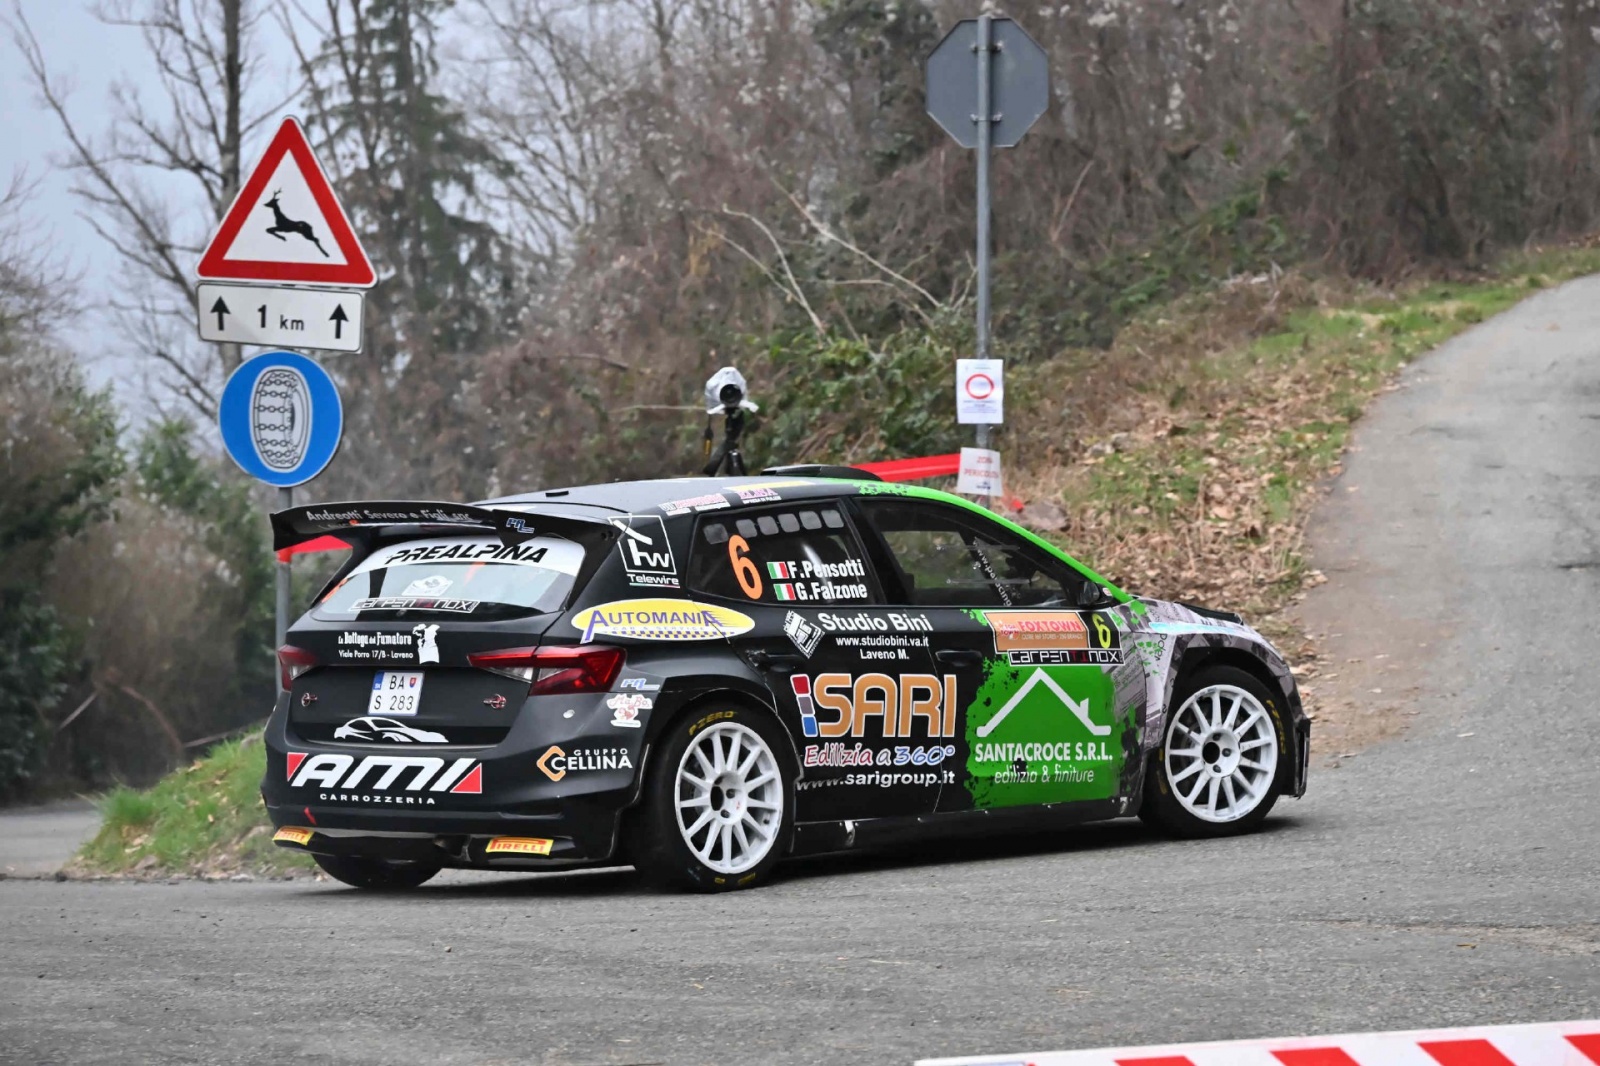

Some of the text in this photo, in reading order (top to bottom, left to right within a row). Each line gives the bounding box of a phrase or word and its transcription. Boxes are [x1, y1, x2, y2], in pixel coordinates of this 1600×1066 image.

[257, 304, 304, 331] 1 km
[306, 509, 361, 522] Andreotti
[366, 510, 404, 520] Severo
[385, 544, 549, 565] PREALPINA
[728, 534, 763, 600] 6
[788, 559, 866, 579] F.Pensotti
[627, 573, 679, 585] Telewire
[795, 581, 868, 601] G.Falzone
[817, 612, 934, 632] Studio Bini
[1017, 621, 1083, 632] FOXTOWN
[376, 631, 412, 646] Fumatore
[1092, 613, 1111, 649] 6
[835, 635, 929, 648] www.studiobini.va.it
[338, 649, 353, 658] Viale
[354, 650, 370, 658] Porro
[391, 650, 414, 659] Laveno
[860, 648, 910, 660] Laveno M.
[389, 675, 405, 690] BA
[374, 695, 414, 710] S 283
[813, 672, 957, 738] SARI
[573, 748, 628, 757] GRUPPO
[804, 743, 956, 767] Edilizia a 360°
[975, 742, 1113, 762] SANTACROCE S.R.L.
[551, 755, 633, 770] CELLINA
[291, 754, 476, 792] AMI
[796, 771, 956, 791] www.sarigroup.it
[994, 763, 1095, 784] edilizia & finiture
[320, 793, 436, 804] CARROZZERIA
[490, 838, 546, 853] PIRELLI
